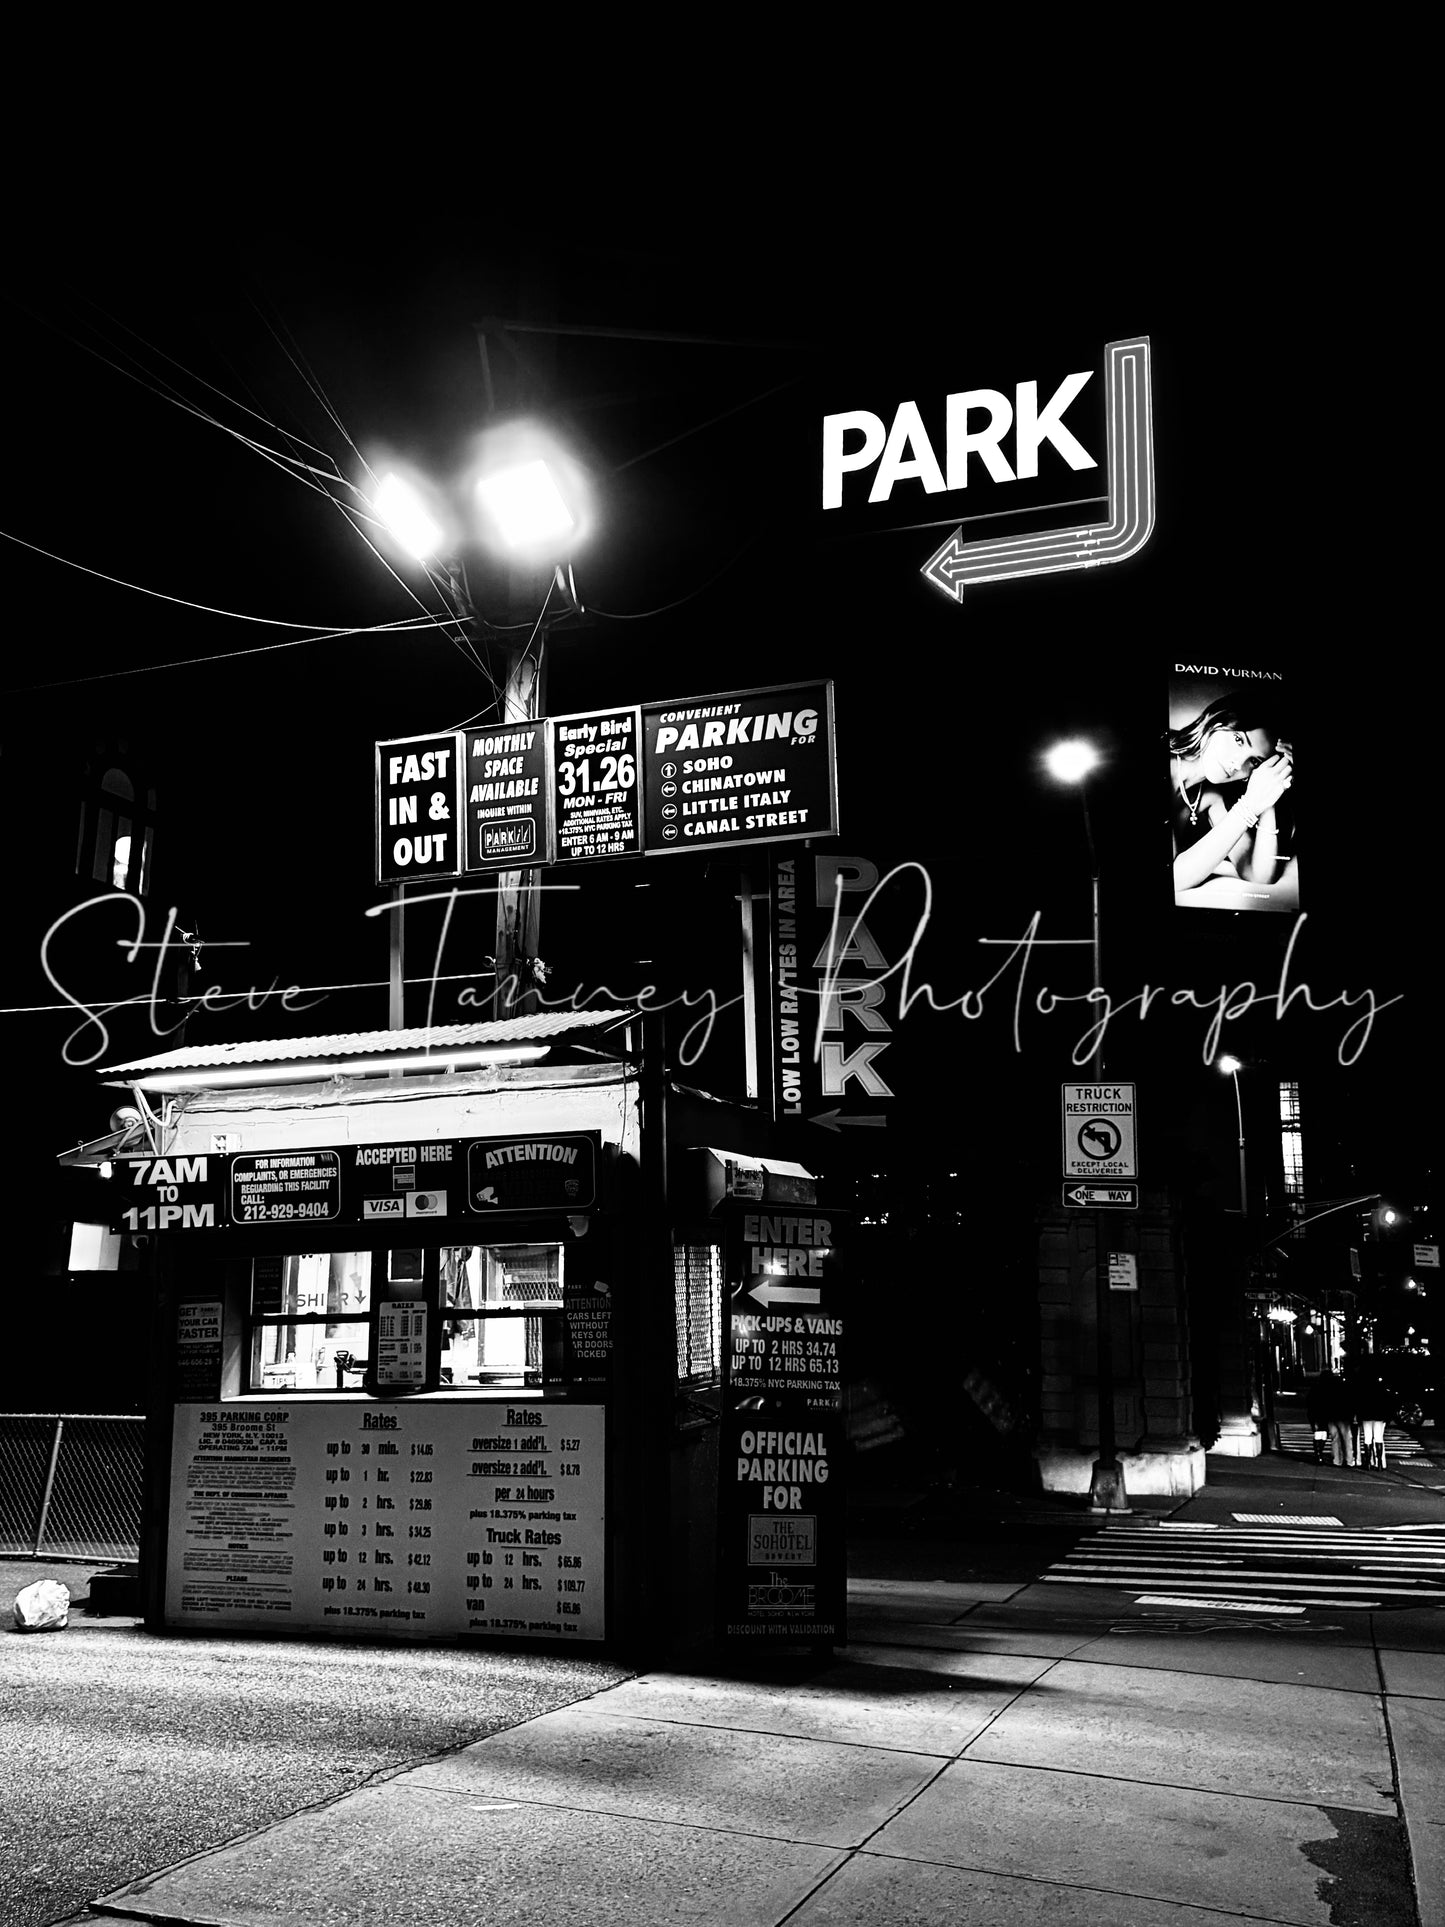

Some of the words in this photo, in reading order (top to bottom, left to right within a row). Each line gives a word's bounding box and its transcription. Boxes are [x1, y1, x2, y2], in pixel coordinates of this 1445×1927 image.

[823, 370, 1098, 510] PARK
[1174, 663, 1218, 675] DAVID
[1222, 667, 1282, 681] YURMAN
[659, 703, 742, 723] CONVENIENT
[559, 723, 598, 742] Early
[600, 716, 632, 736] Bird
[654, 708, 819, 754] PARKING
[473, 731, 535, 757] MONTHLY
[564, 737, 627, 759] Special
[790, 734, 816, 746] FOR
[389, 750, 450, 786] FAST
[484, 757, 524, 778] SPACE
[682, 755, 734, 775] SOHO
[558, 754, 635, 796] 31.26
[681, 769, 786, 796] CHINATOWN
[470, 777, 539, 803] AVAILABLE
[390, 796, 418, 825] IN
[430, 791, 450, 821] &
[564, 795, 595, 809] MON
[605, 791, 627, 804] FRI
[682, 796, 739, 816] LITTLE
[744, 789, 792, 809] ITALY
[477, 807, 505, 819] INQUIRE
[506, 803, 532, 816] WITHIN
[563, 816, 595, 827] ADDITIONAL
[596, 814, 613, 823] RATES
[614, 812, 632, 821] APPLY
[558, 824, 583, 835] +18.375%
[584, 824, 596, 833] NYC
[596, 821, 621, 831] PARKING
[622, 820, 633, 828] TAX
[683, 815, 741, 837] CANAL
[745, 809, 809, 830] STREET
[562, 835, 588, 847] ENTER
[589, 834, 594, 844] 6
[596, 832, 608, 843] AM
[614, 830, 620, 840] 9
[622, 829, 634, 840] AM
[394, 834, 445, 867] OUT
[487, 845, 529, 854] MANAGEMENT
[571, 847, 582, 856] UP
[584, 846, 594, 855] TO
[596, 844, 606, 854] 12
[608, 842, 624, 852] HRS
[777, 859, 797, 915] AREA
[779, 917, 798, 939] IN
[779, 943, 800, 1018] RATES
[812, 855, 895, 1097] PARK
[781, 1018, 800, 1064] LOW
[782, 1069, 802, 1115] LOW
[1076, 1088, 1121, 1099] TRUCK
[1067, 1103, 1132, 1112] RESTRICTION
[255, 1159, 268, 1169] FOR
[270, 1156, 315, 1168] INFORMATION
[355, 1147, 417, 1166] ACCEPTED
[421, 1144, 453, 1162] HERE
[485, 1144, 578, 1169] ATTENTION
[129, 1156, 208, 1186] 7AM
[234, 1171, 278, 1182] COMPLAINTS,
[279, 1170, 288, 1180] OR
[290, 1167, 337, 1179] EMERGENCIES
[157, 1185, 179, 1203] TO
[241, 1182, 283, 1194] REGUARDING
[285, 1181, 300, 1191] THIS
[301, 1180, 330, 1191] FACILITY
[1075, 1190, 1095, 1200] ONE
[1108, 1191, 1129, 1201] WAY
[241, 1195, 265, 1205] CALL:
[369, 1200, 400, 1212] VISA
[121, 1204, 214, 1230] 11PM
[244, 1202, 329, 1220] 212-929-9404
[744, 1215, 832, 1246] ENTER
[751, 1246, 824, 1278] HERE
[179, 1308, 197, 1316] GET
[565, 1297, 612, 1310] ATTENTION
[179, 1328, 218, 1338] FASTER
[731, 1315, 793, 1334] PICK-UPS
[794, 1318, 805, 1333] &
[808, 1318, 843, 1336] VANS
[571, 1331, 593, 1339] KEYS
[596, 1331, 608, 1339] OR
[585, 1340, 614, 1348] DOORS
[735, 1338, 750, 1354] UP
[752, 1339, 766, 1354] TO
[772, 1341, 779, 1355] 2
[782, 1340, 803, 1356] HRS
[806, 1341, 836, 1357] 34.74
[732, 1355, 747, 1370] UP
[748, 1356, 762, 1371] TO
[768, 1357, 782, 1371] 12
[785, 1357, 806, 1372] HRS
[809, 1359, 839, 1374] 65.13
[768, 1379, 785, 1388] NYC
[787, 1379, 823, 1390] PARKING
[824, 1380, 841, 1390] TAX
[201, 1412, 217, 1421] 395
[221, 1413, 261, 1421] PARKING
[264, 1413, 289, 1421] CORP
[363, 1413, 398, 1429] Rates
[506, 1409, 542, 1425] Rates
[472, 1436, 512, 1450] oversize
[520, 1436, 547, 1450] add'l.
[740, 1430, 827, 1456] OFFICIAL
[737, 1457, 829, 1484] PARKING
[495, 1486, 511, 1502] per
[516, 1488, 525, 1500] 24
[527, 1486, 554, 1501] hours
[763, 1486, 802, 1510] FOR
[470, 1510, 488, 1520] plus
[490, 1510, 526, 1520] 18.375%
[528, 1511, 560, 1522] parking
[563, 1512, 576, 1521] tax
[486, 1528, 521, 1544] Truck
[525, 1529, 562, 1544] Rates
[773, 1522, 795, 1534] THE
[753, 1535, 812, 1550] SOHOTEL
[770, 1571, 789, 1586] The
[748, 1587, 816, 1605] BROOME
[470, 1618, 488, 1628] plus
[490, 1618, 526, 1629] 18.375%
[529, 1620, 561, 1632] parking
[564, 1622, 578, 1632] tax
[727, 1624, 767, 1636] DISCOUNT
[768, 1625, 788, 1635] WITH
[789, 1624, 835, 1634] VALIDATION
